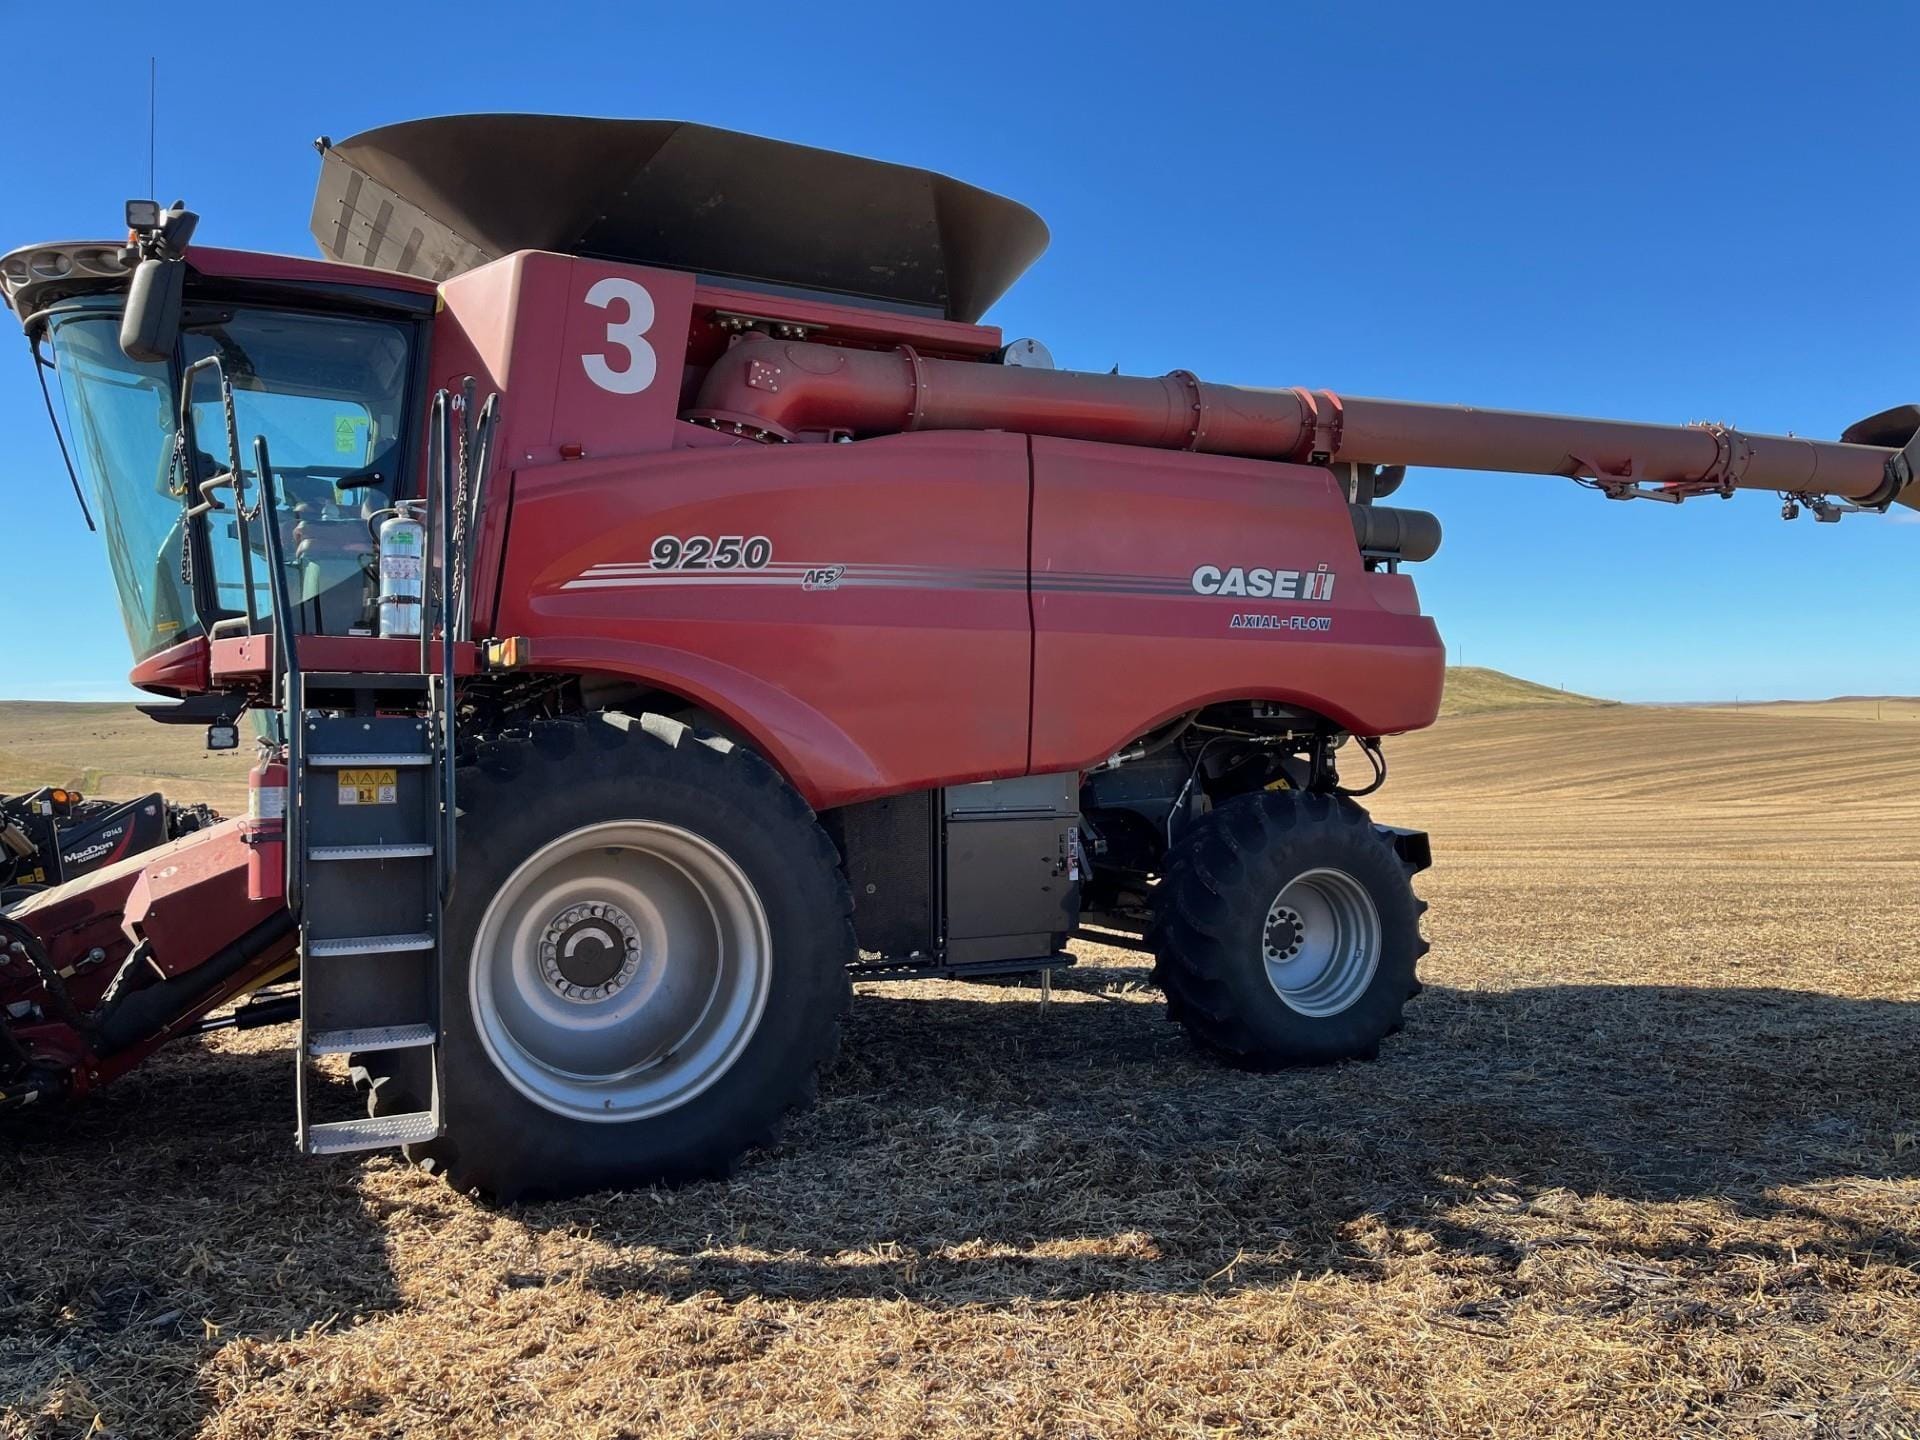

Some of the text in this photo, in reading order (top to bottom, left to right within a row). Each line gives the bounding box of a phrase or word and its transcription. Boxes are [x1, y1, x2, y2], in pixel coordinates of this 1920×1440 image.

[581, 277, 657, 395] 3
[649, 535, 772, 570] 9250
[802, 569, 837, 584] AFS
[1192, 565, 1299, 598] CASE
[1230, 614, 1331, 630] AXIAL-FLOW
[63, 841, 114, 863] MacDon
